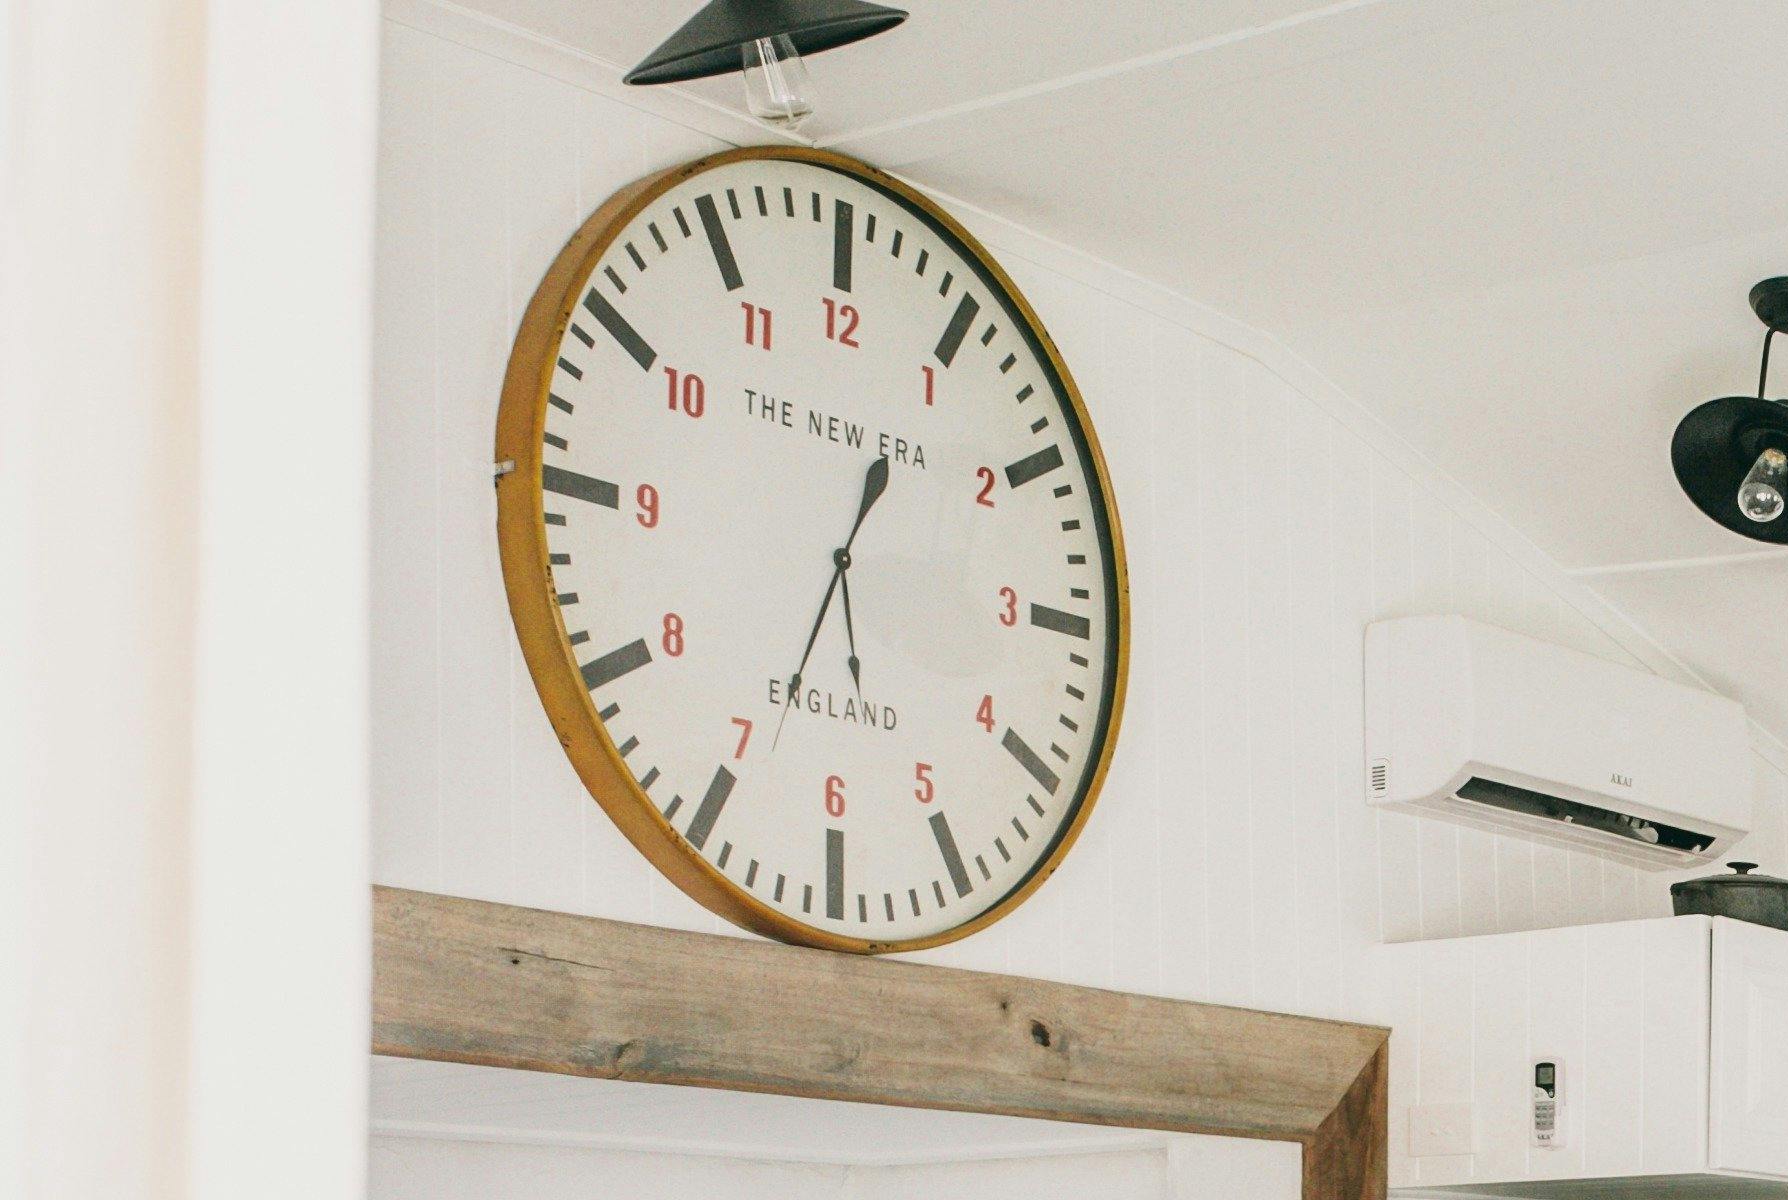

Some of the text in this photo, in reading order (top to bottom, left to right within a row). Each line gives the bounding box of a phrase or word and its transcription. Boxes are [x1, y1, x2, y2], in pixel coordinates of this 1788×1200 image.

[741, 302, 772, 351] 11
[822, 298, 861, 349] 12
[664, 366, 706, 419] 10
[921, 365, 934, 406] 1
[744, 387, 927, 471] THE NEW ERA
[635, 484, 660, 529] 9
[975, 466, 996, 508] 2
[998, 586, 1018, 628] 3
[660, 612, 685, 659] 8
[767, 678, 898, 731] ENGLAND
[975, 694, 996, 734] 4
[731, 716, 753, 760] 7
[824, 774, 846, 818] 6
[914, 762, 935, 804] 5
